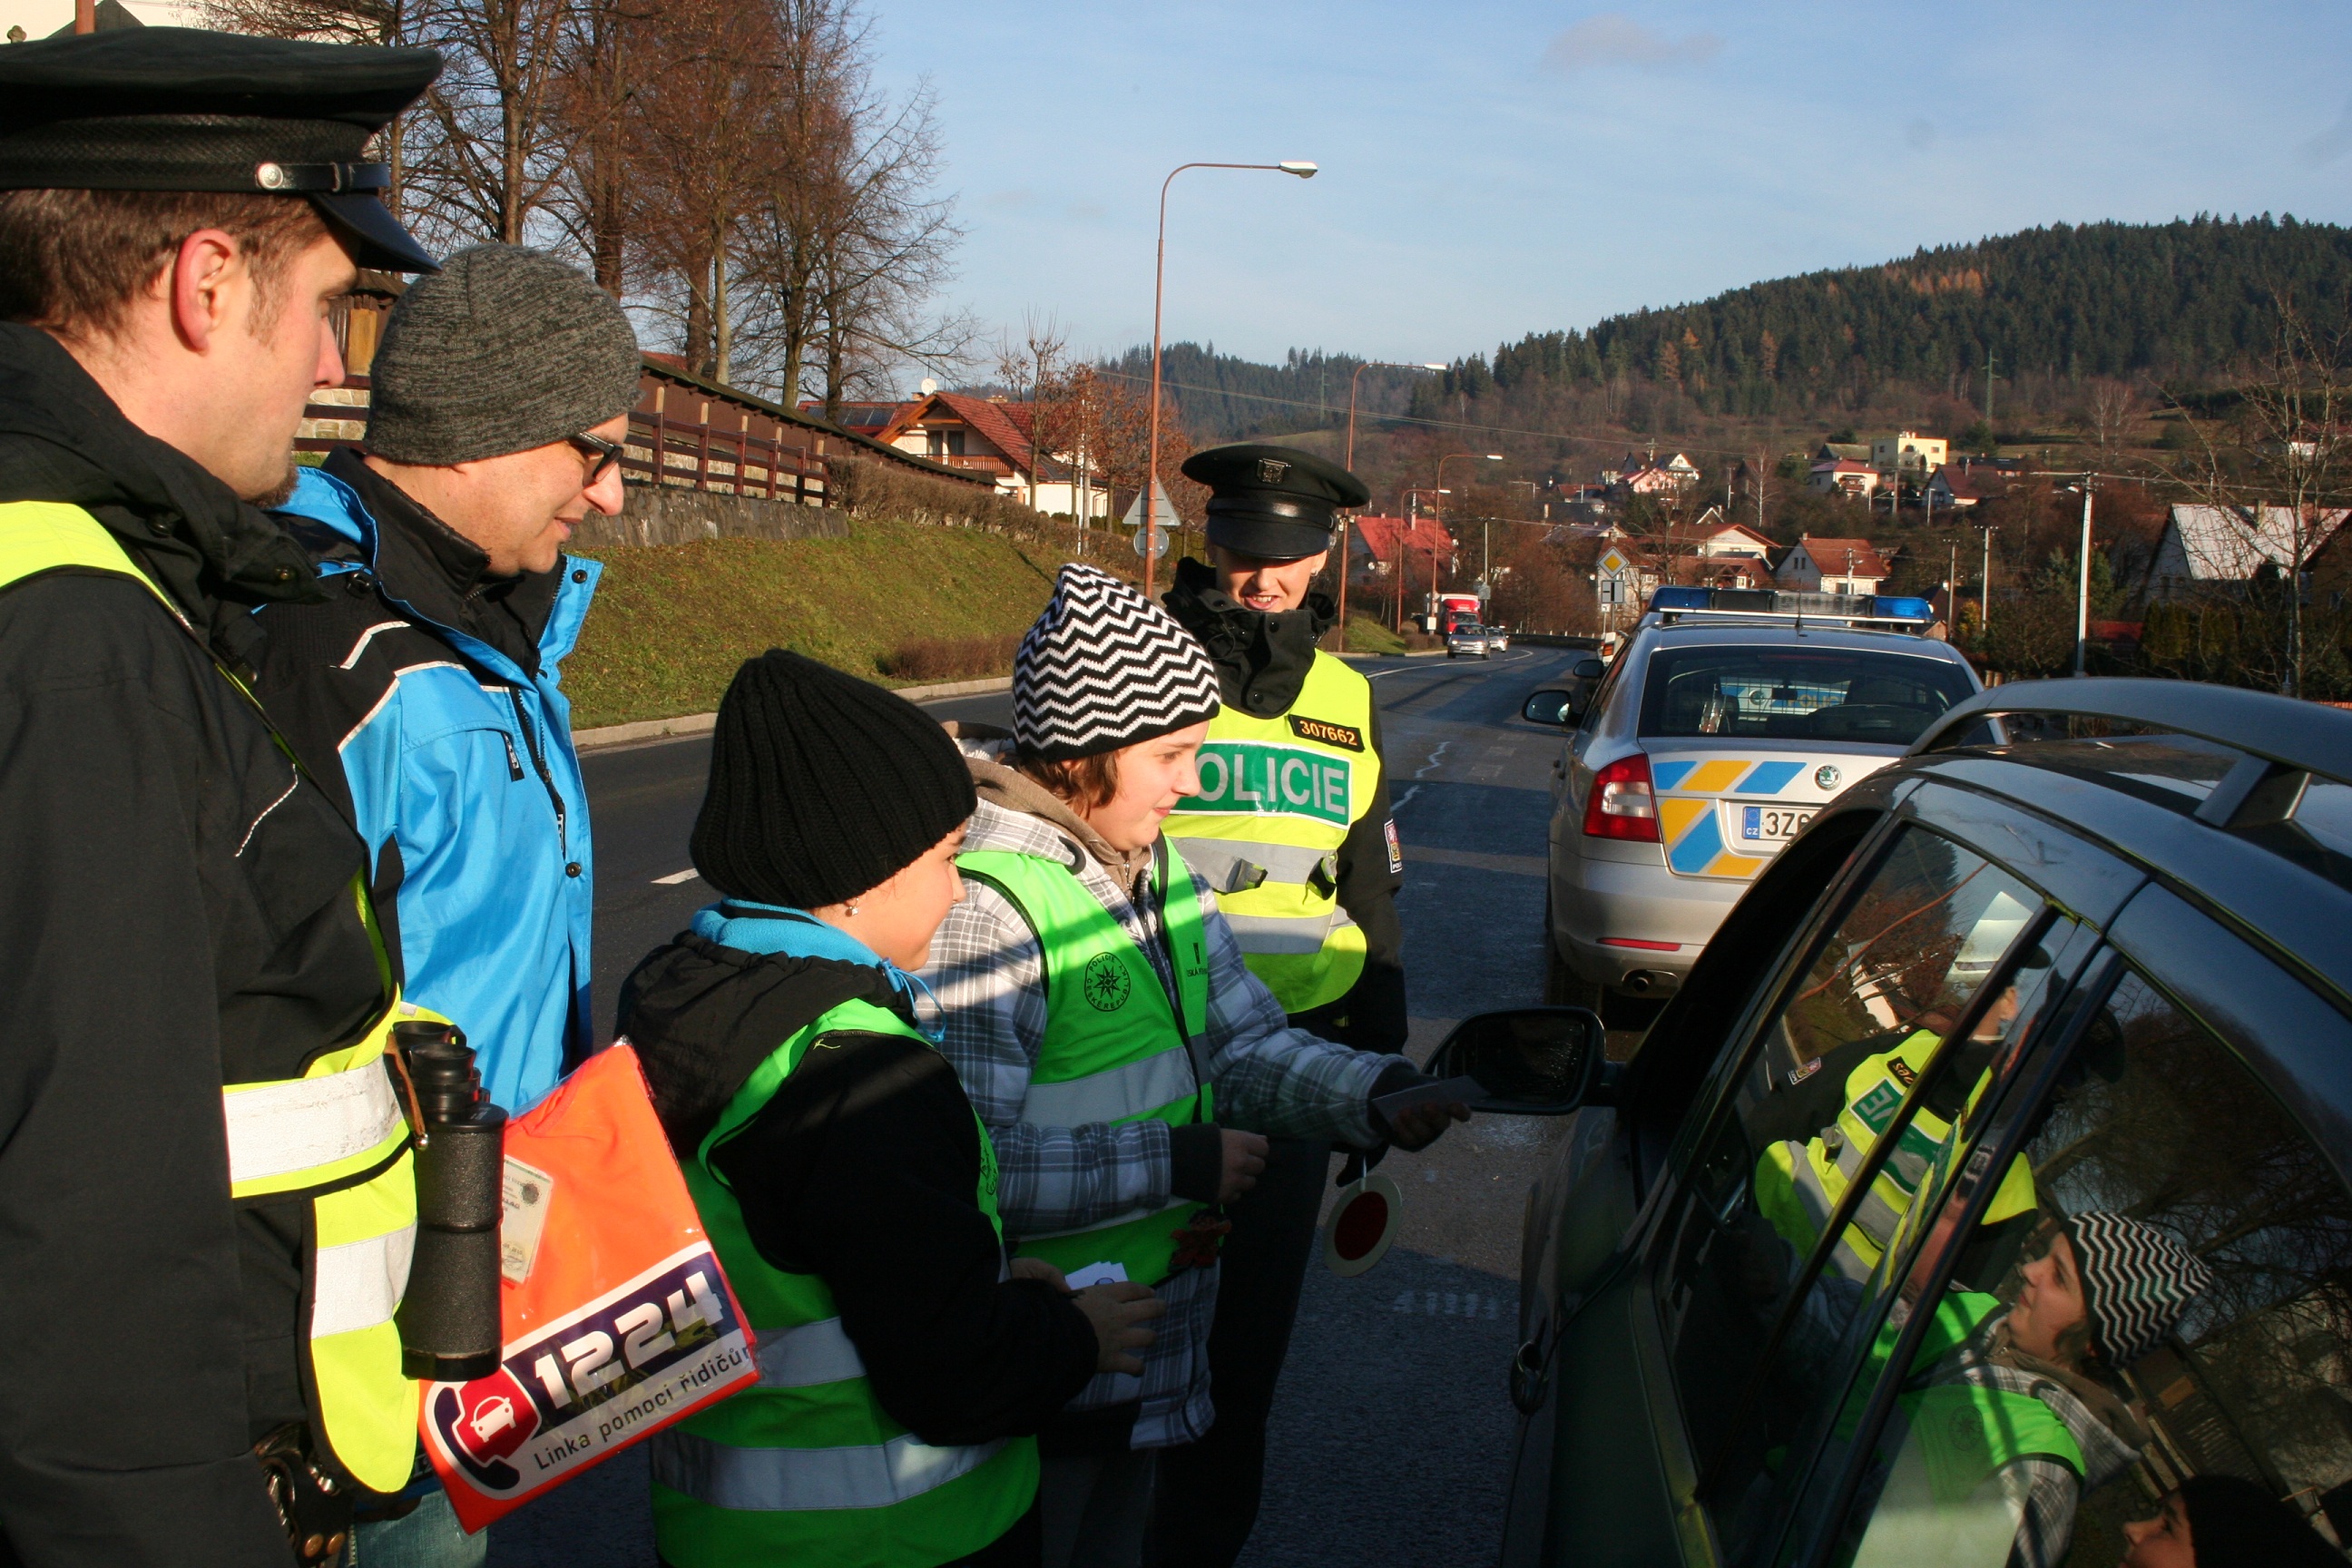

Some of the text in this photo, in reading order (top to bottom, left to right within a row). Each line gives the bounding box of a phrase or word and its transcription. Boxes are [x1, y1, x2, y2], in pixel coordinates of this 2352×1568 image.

[1299, 720, 1357, 746] 307662
[1196, 752, 1346, 815] OLICIE
[1746, 827, 1759, 836] CZ
[1089, 955, 1115, 972] POLICIE
[535, 1270, 724, 1410] 1224
[534, 1431, 592, 1470] Linka
[598, 1384, 675, 1446] pomoci
